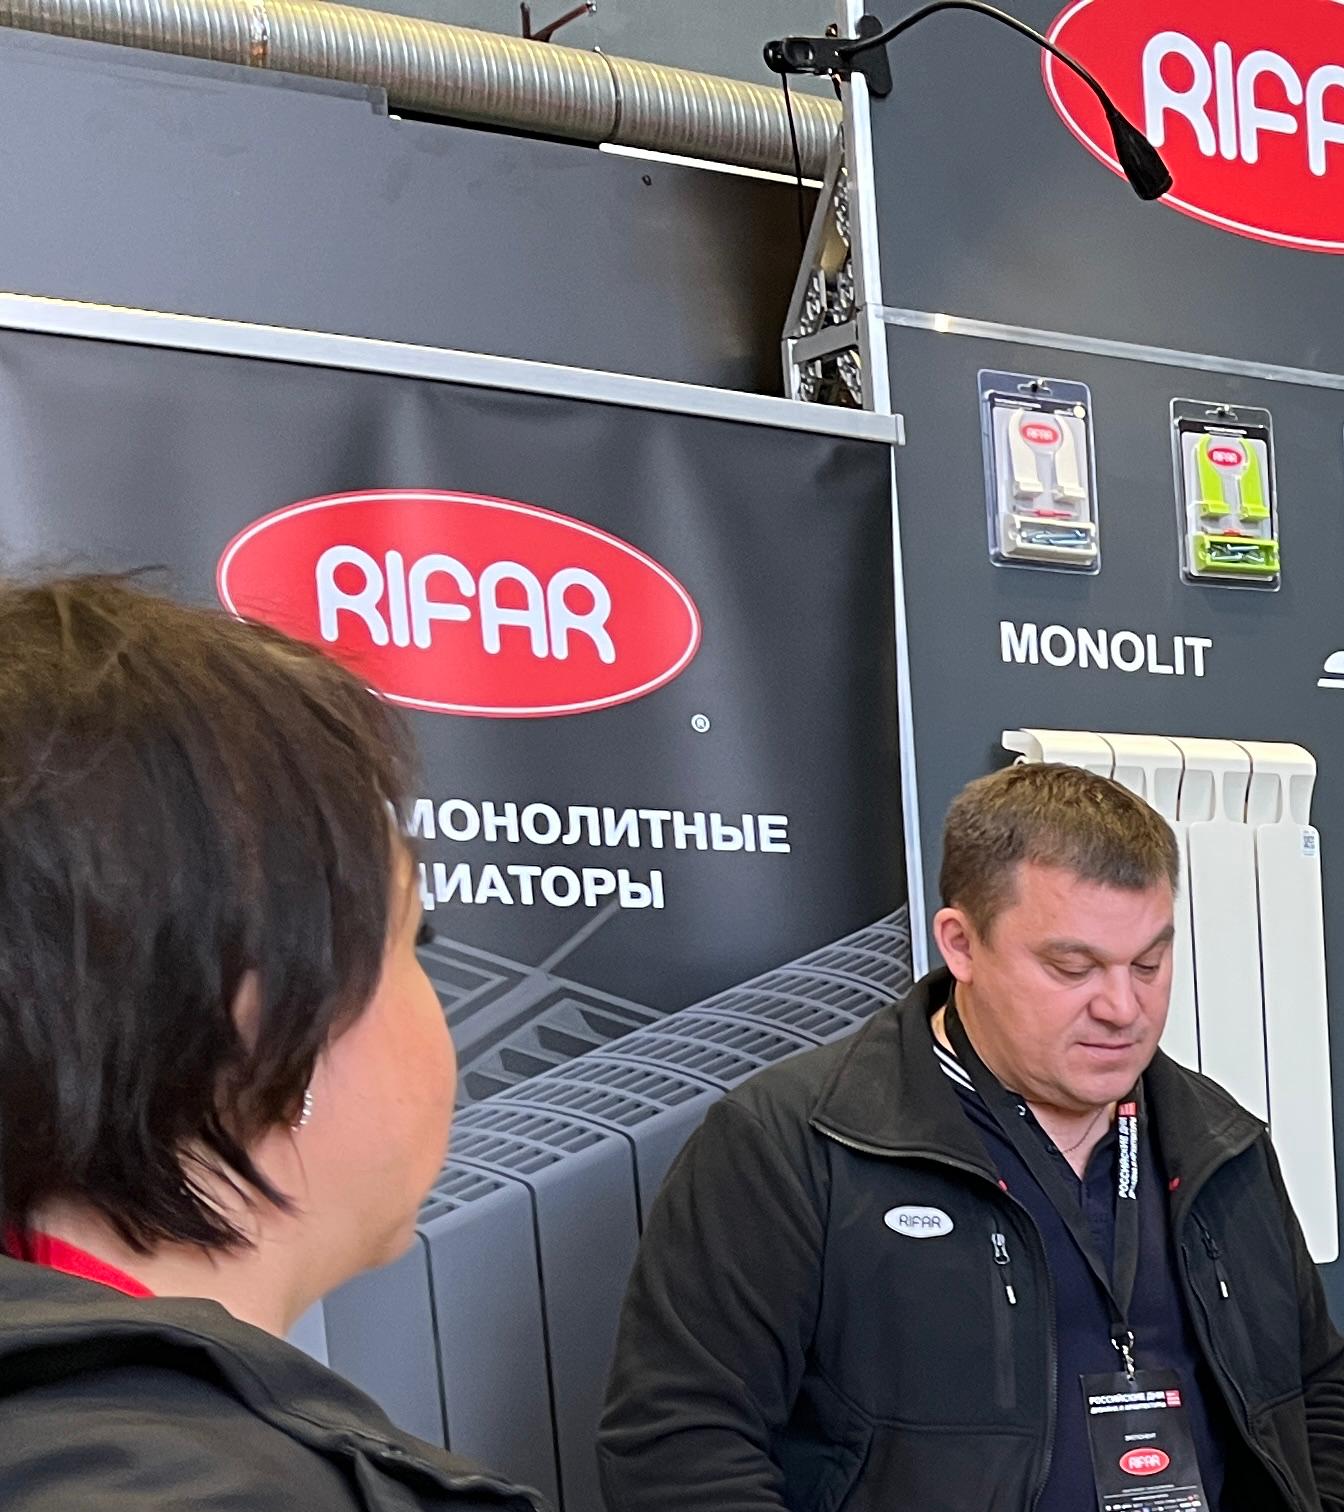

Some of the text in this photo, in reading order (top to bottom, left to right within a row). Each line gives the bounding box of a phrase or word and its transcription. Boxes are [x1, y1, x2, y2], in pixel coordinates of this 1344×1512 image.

[315, 544, 617, 665] RIFAR
[1000, 620, 1213, 678] MONOLIT
[899, 1214, 942, 1229] RIFAR
